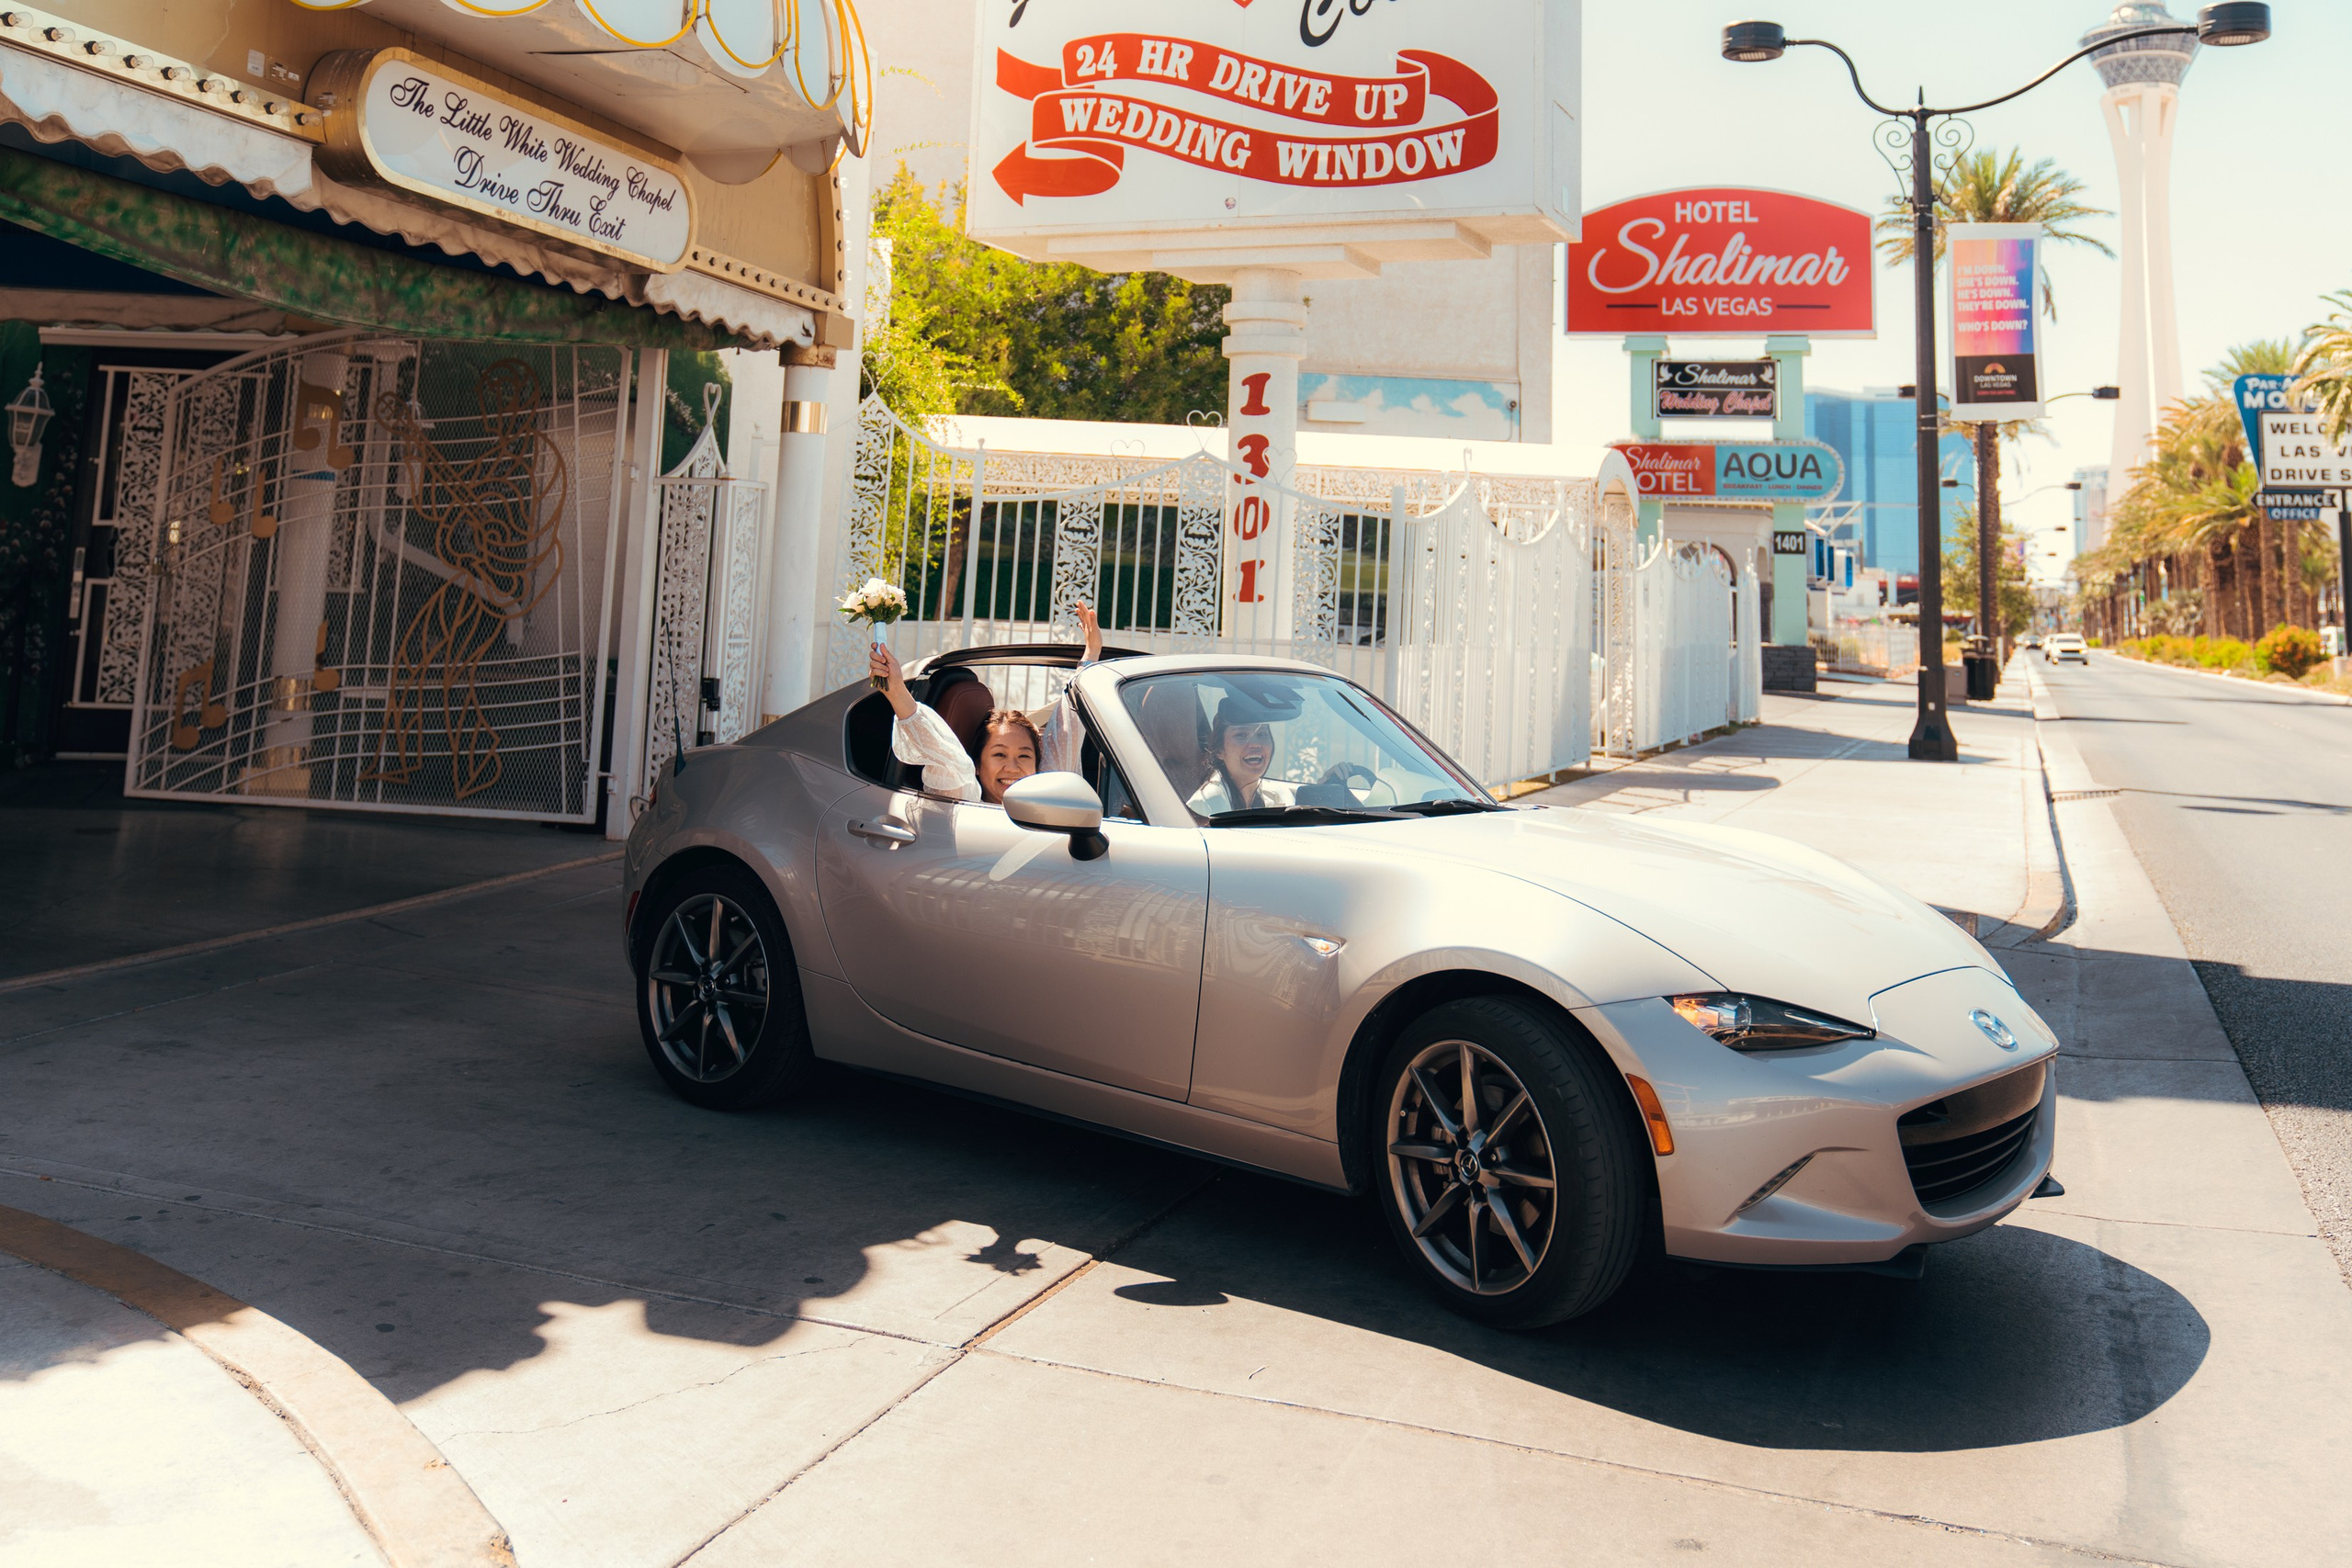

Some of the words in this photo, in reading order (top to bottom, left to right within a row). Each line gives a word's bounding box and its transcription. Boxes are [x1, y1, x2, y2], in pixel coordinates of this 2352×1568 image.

[1075, 41, 1118, 78] 24
[1136, 39, 1195, 81] HR
[1208, 53, 1332, 116] DRIVE
[1354, 84, 1408, 121] UP
[390, 77, 435, 118] The
[439, 92, 493, 141] Little
[499, 116, 548, 163] White
[554, 139, 620, 199] Wedding
[626, 166, 676, 214] Chapel
[1059, 97, 1252, 171] WEDDING
[1275, 129, 1466, 181] WINDOW
[454, 146, 519, 204] Drive
[526, 180, 581, 227] Thru
[589, 196, 627, 241] Exit
[1675, 200, 1758, 223] HOTEL
[1588, 218, 1849, 293] Shalimar
[1984, 276, 2019, 286] DOWN.
[1979, 288, 2014, 298] DOWN.
[1662, 297, 1698, 316] LAS
[1703, 297, 1773, 316] VEGAS
[1995, 299, 2030, 310] DOWN.
[1958, 321, 1989, 332] WHO'S
[1991, 320, 2028, 332] DOWN?
[1675, 364, 1758, 386] Shalimar
[1973, 375, 2018, 383] DOWNTOWN
[1659, 391, 1720, 415] Wedding
[1723, 390, 1773, 415] Chapel
[1625, 446, 1702, 470] Shalimar
[2280, 446, 2321, 457] LAS
[1724, 452, 1823, 481] AQUA
[2270, 468, 2332, 480] DRIVE
[1635, 471, 1702, 492] OTEL
[2256, 493, 2333, 507] ENTRANCE
[2270, 507, 2318, 520] OFFICE
[1775, 534, 1805, 551] 1401
